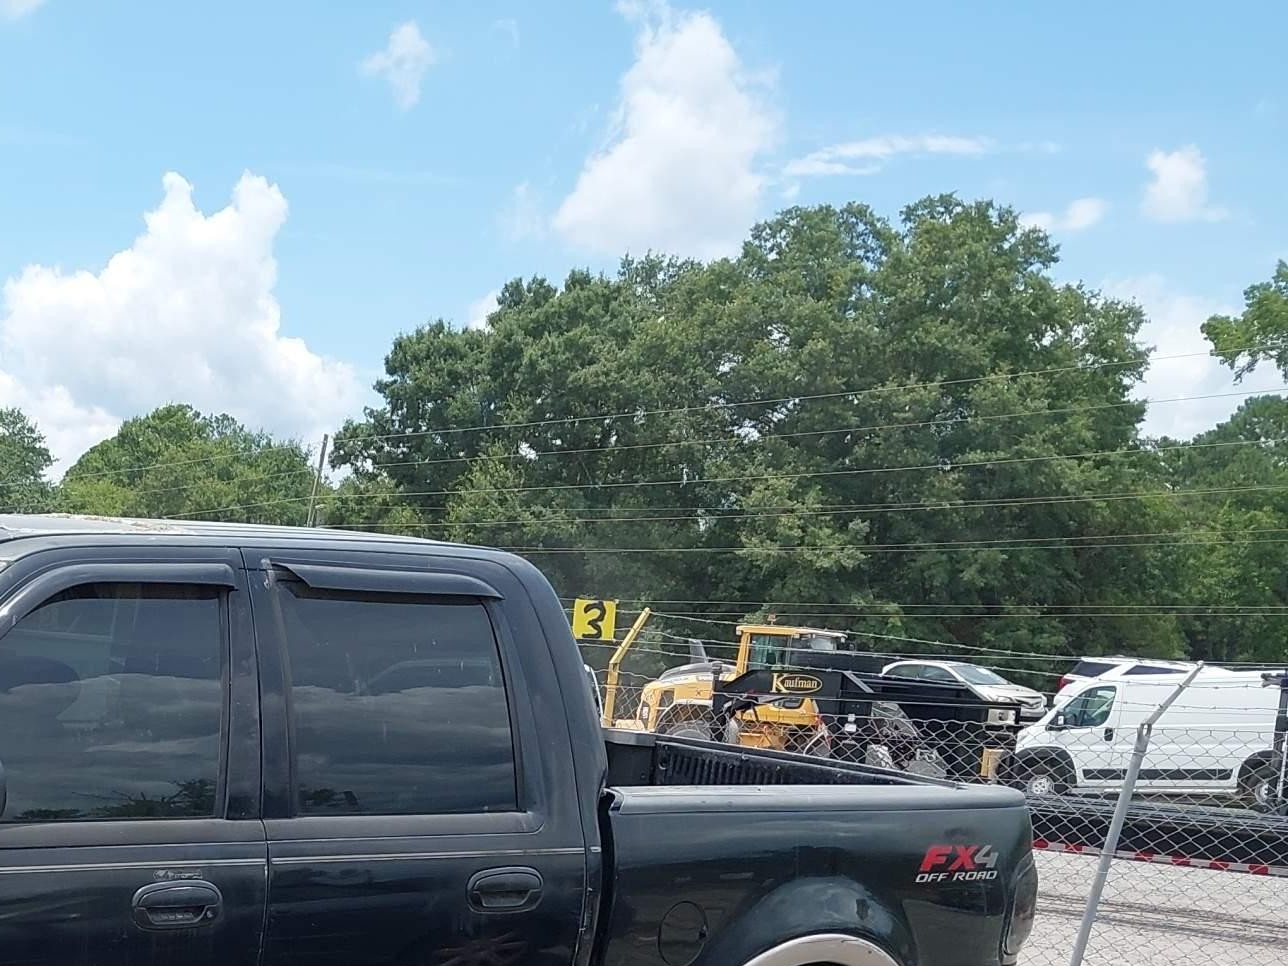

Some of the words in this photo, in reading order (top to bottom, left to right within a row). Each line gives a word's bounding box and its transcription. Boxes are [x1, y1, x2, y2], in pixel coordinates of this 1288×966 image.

[581, 600, 607, 639] 3
[769, 672, 818, 693] Kaufman
[919, 844, 1000, 871] FX4
[915, 872, 950, 883] OFF
[952, 870, 999, 881] ROAD
